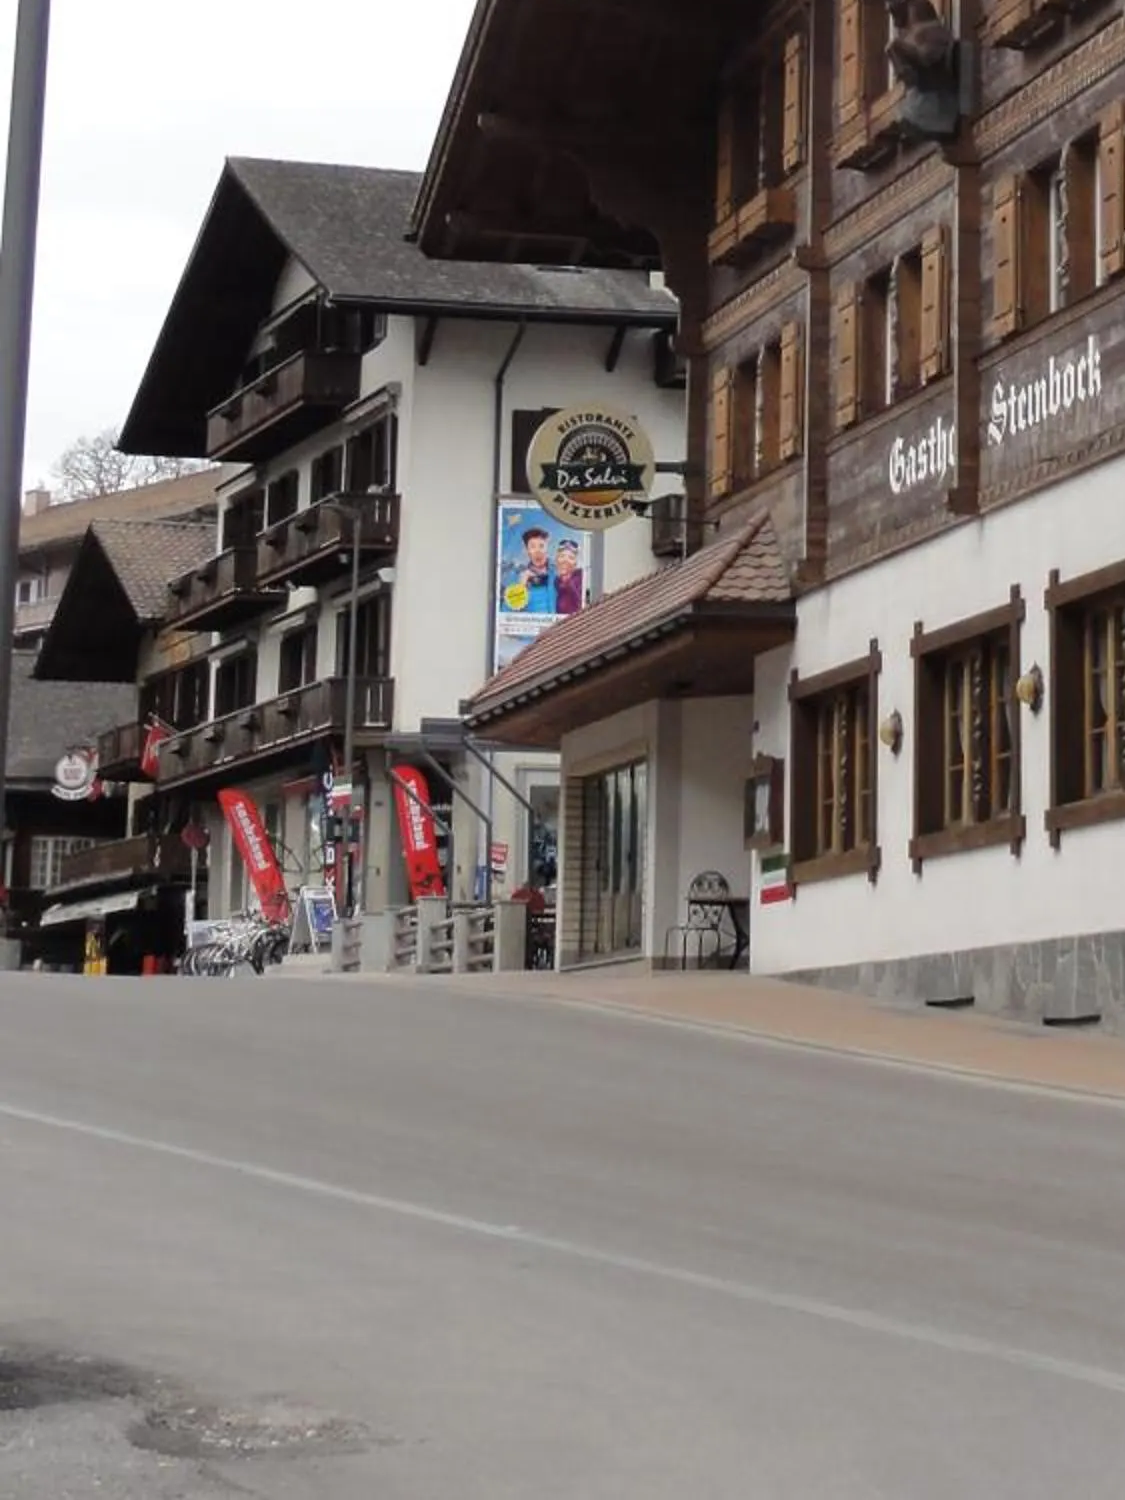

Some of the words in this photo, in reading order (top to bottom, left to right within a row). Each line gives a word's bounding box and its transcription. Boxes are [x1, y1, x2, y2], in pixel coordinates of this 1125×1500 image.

[987, 334, 1102, 446] Steinbock
[557, 413, 635, 440] RISTORANTE
[556, 469, 581, 489] Da
[889, 416, 956, 494] Gastho
